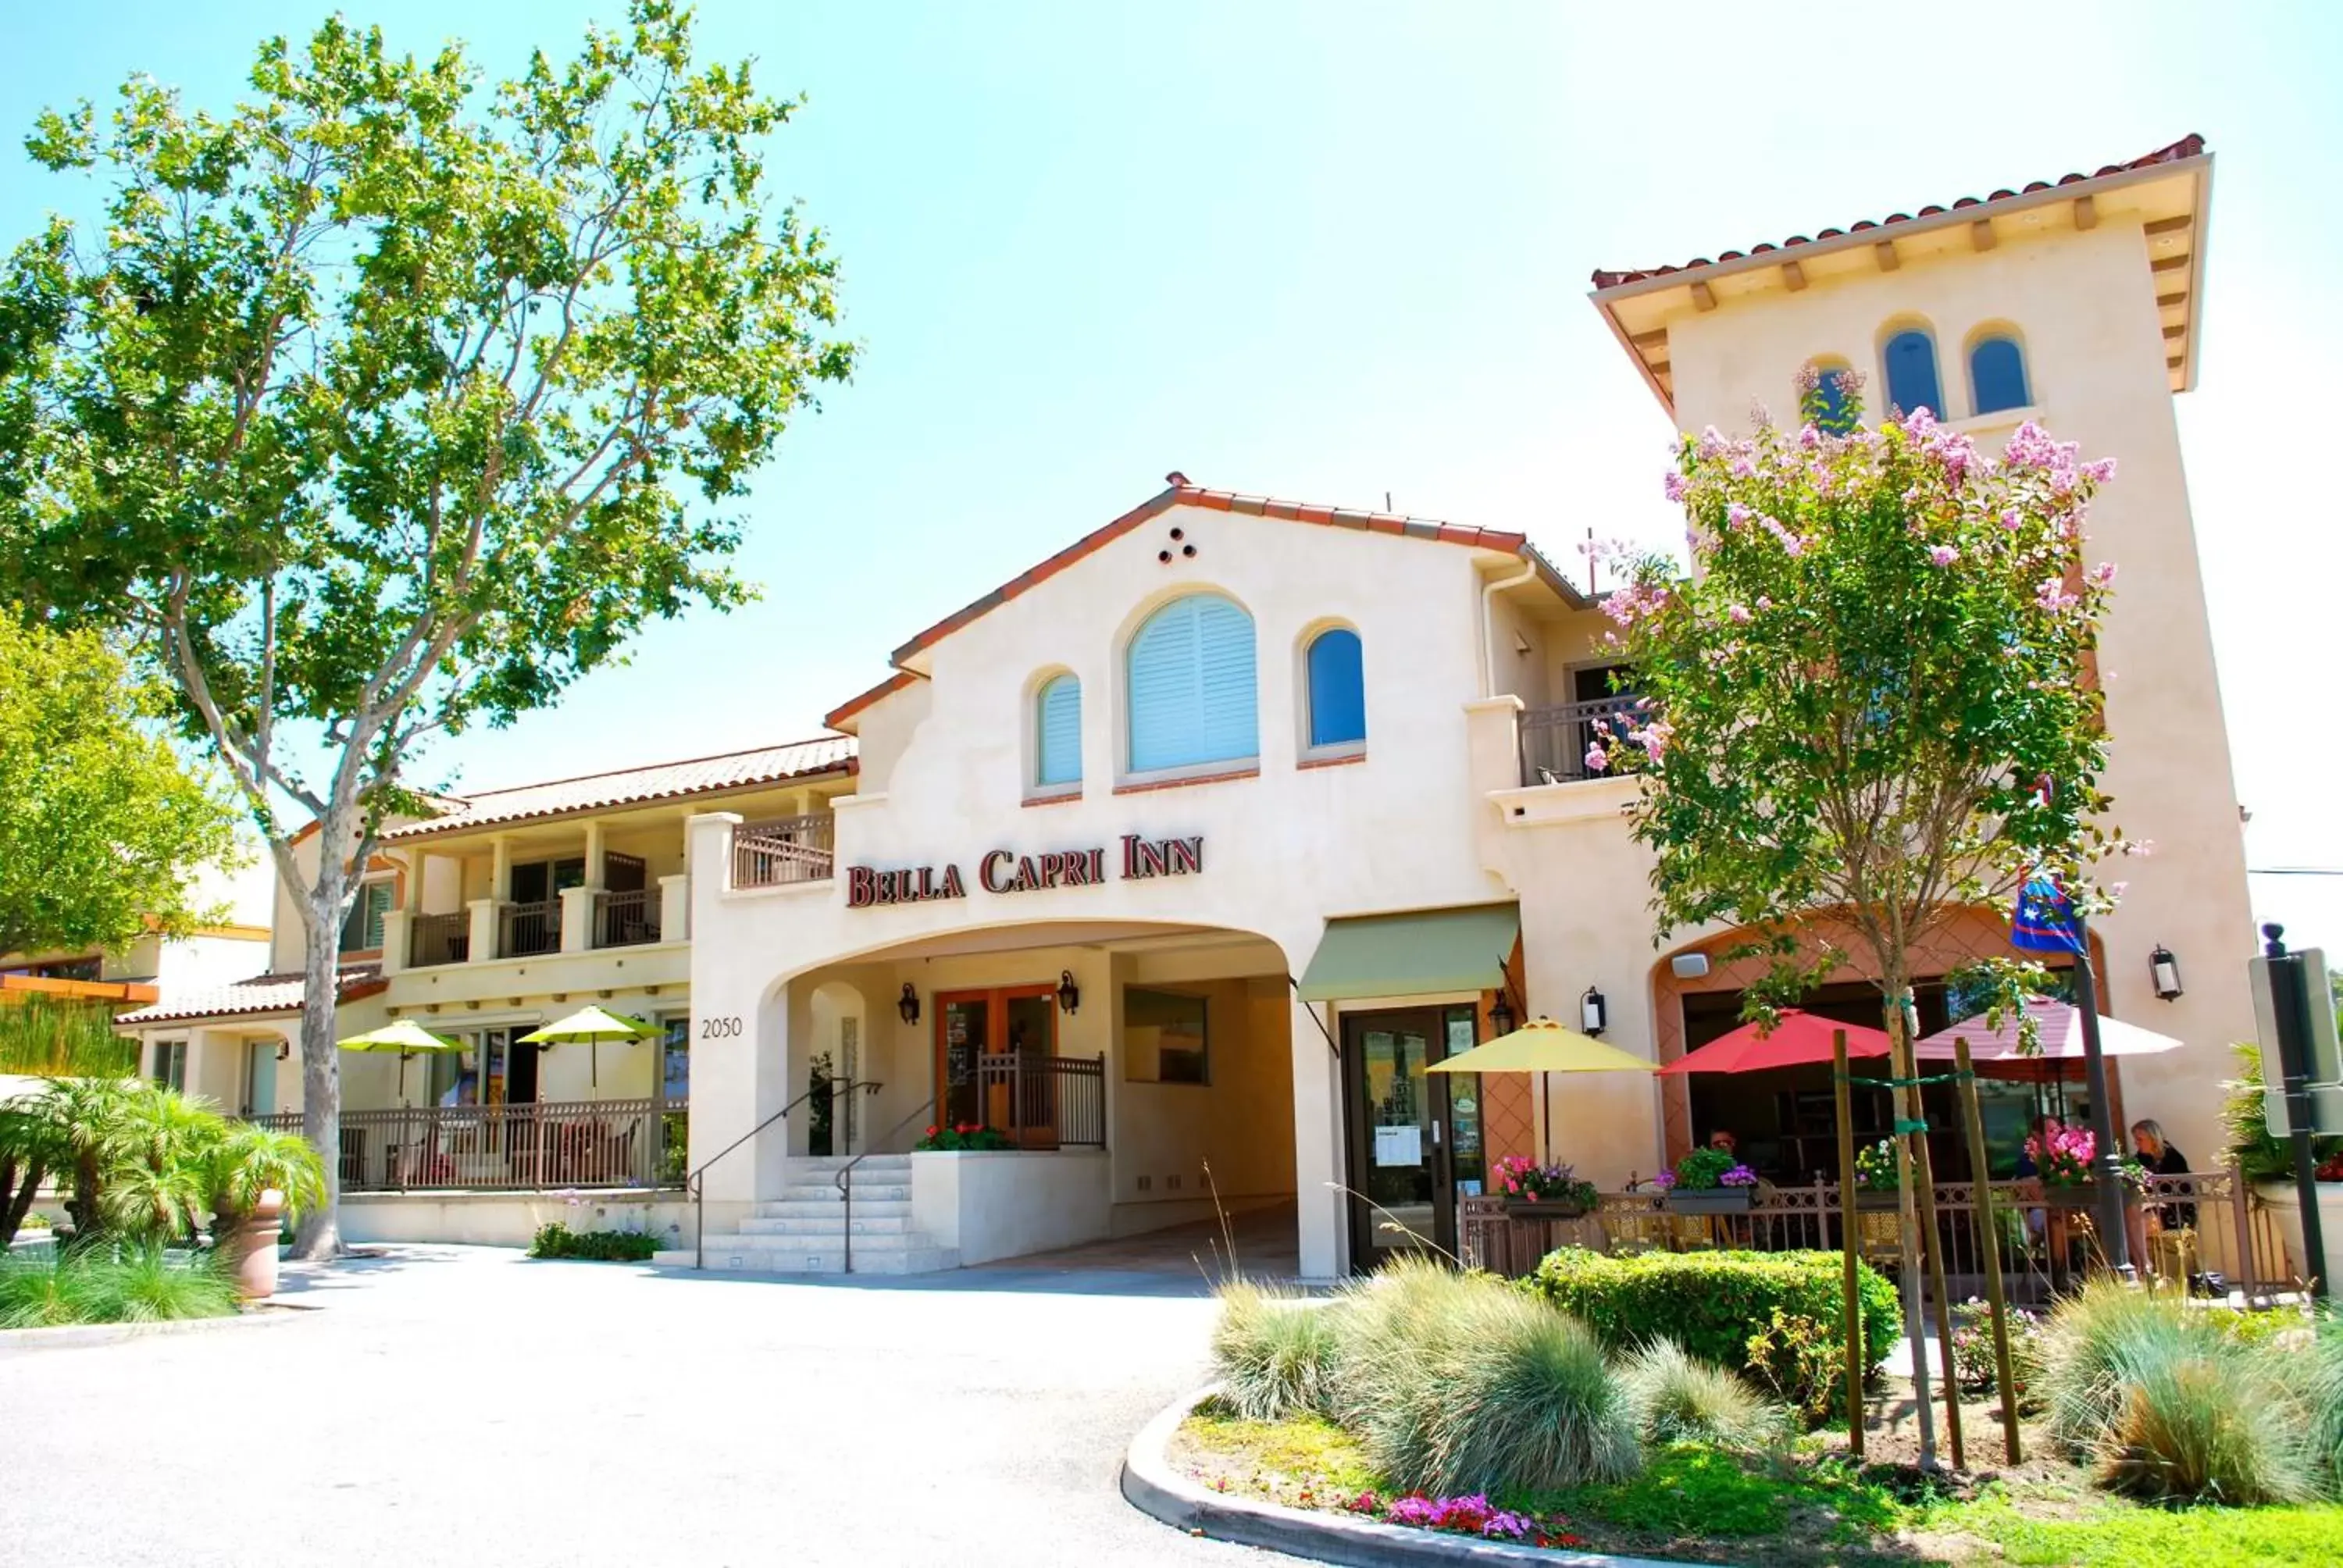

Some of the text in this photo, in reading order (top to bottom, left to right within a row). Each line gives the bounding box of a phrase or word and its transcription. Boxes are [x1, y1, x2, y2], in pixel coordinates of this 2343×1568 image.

[847, 833, 1204, 909] BELLA CAPRI INN
[702, 1017, 743, 1039] 2050
